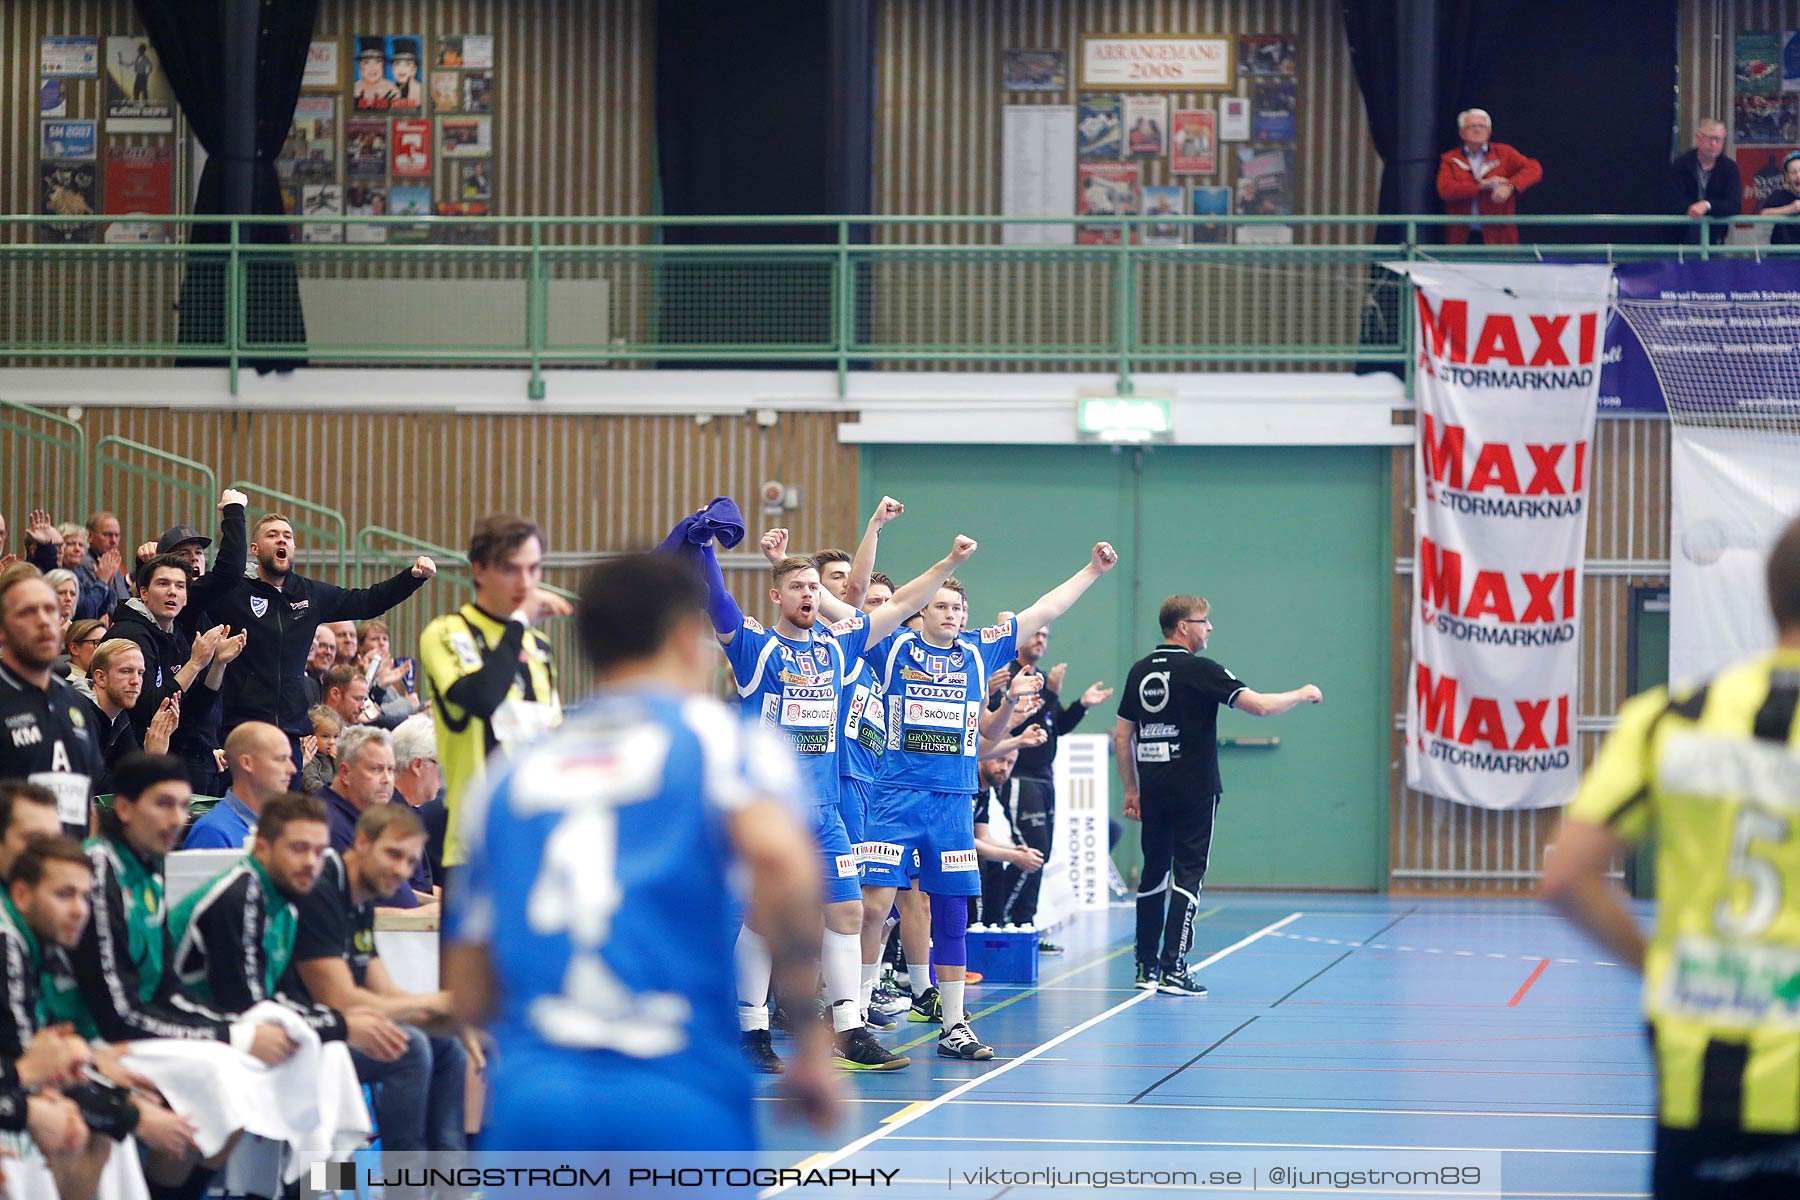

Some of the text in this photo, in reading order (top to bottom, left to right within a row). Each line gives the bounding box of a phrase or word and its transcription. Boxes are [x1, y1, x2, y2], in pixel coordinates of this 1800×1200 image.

[1094, 44, 1221, 61] ARRANGEMANG
[1129, 62, 1184, 79] 2008
[1416, 289, 1597, 366] MAXI
[1440, 366, 1593, 389] STORMARKNAD
[1424, 413, 1587, 496] MAXI
[1441, 489, 1582, 517] STORMARKNAD
[1421, 536, 1575, 623] MAXI
[831, 618, 862, 631] MAXI
[1436, 615, 1575, 647] STORMARKNAD
[786, 688, 832, 698] VOLVO
[907, 686, 964, 699] VOLVO
[1143, 688, 1165, 696] VOLVO
[924, 709, 960, 721] SKÖVDE
[1416, 662, 1569, 752] MAXI
[11, 725, 43, 748] KM
[908, 731, 957, 744] GRÖNSAKS
[920, 742, 950, 752] HUSET
[1429, 740, 1570, 774] STORMARKNAD
[1084, 815, 1095, 905] MODERN
[1712, 806, 1788, 940] 5
